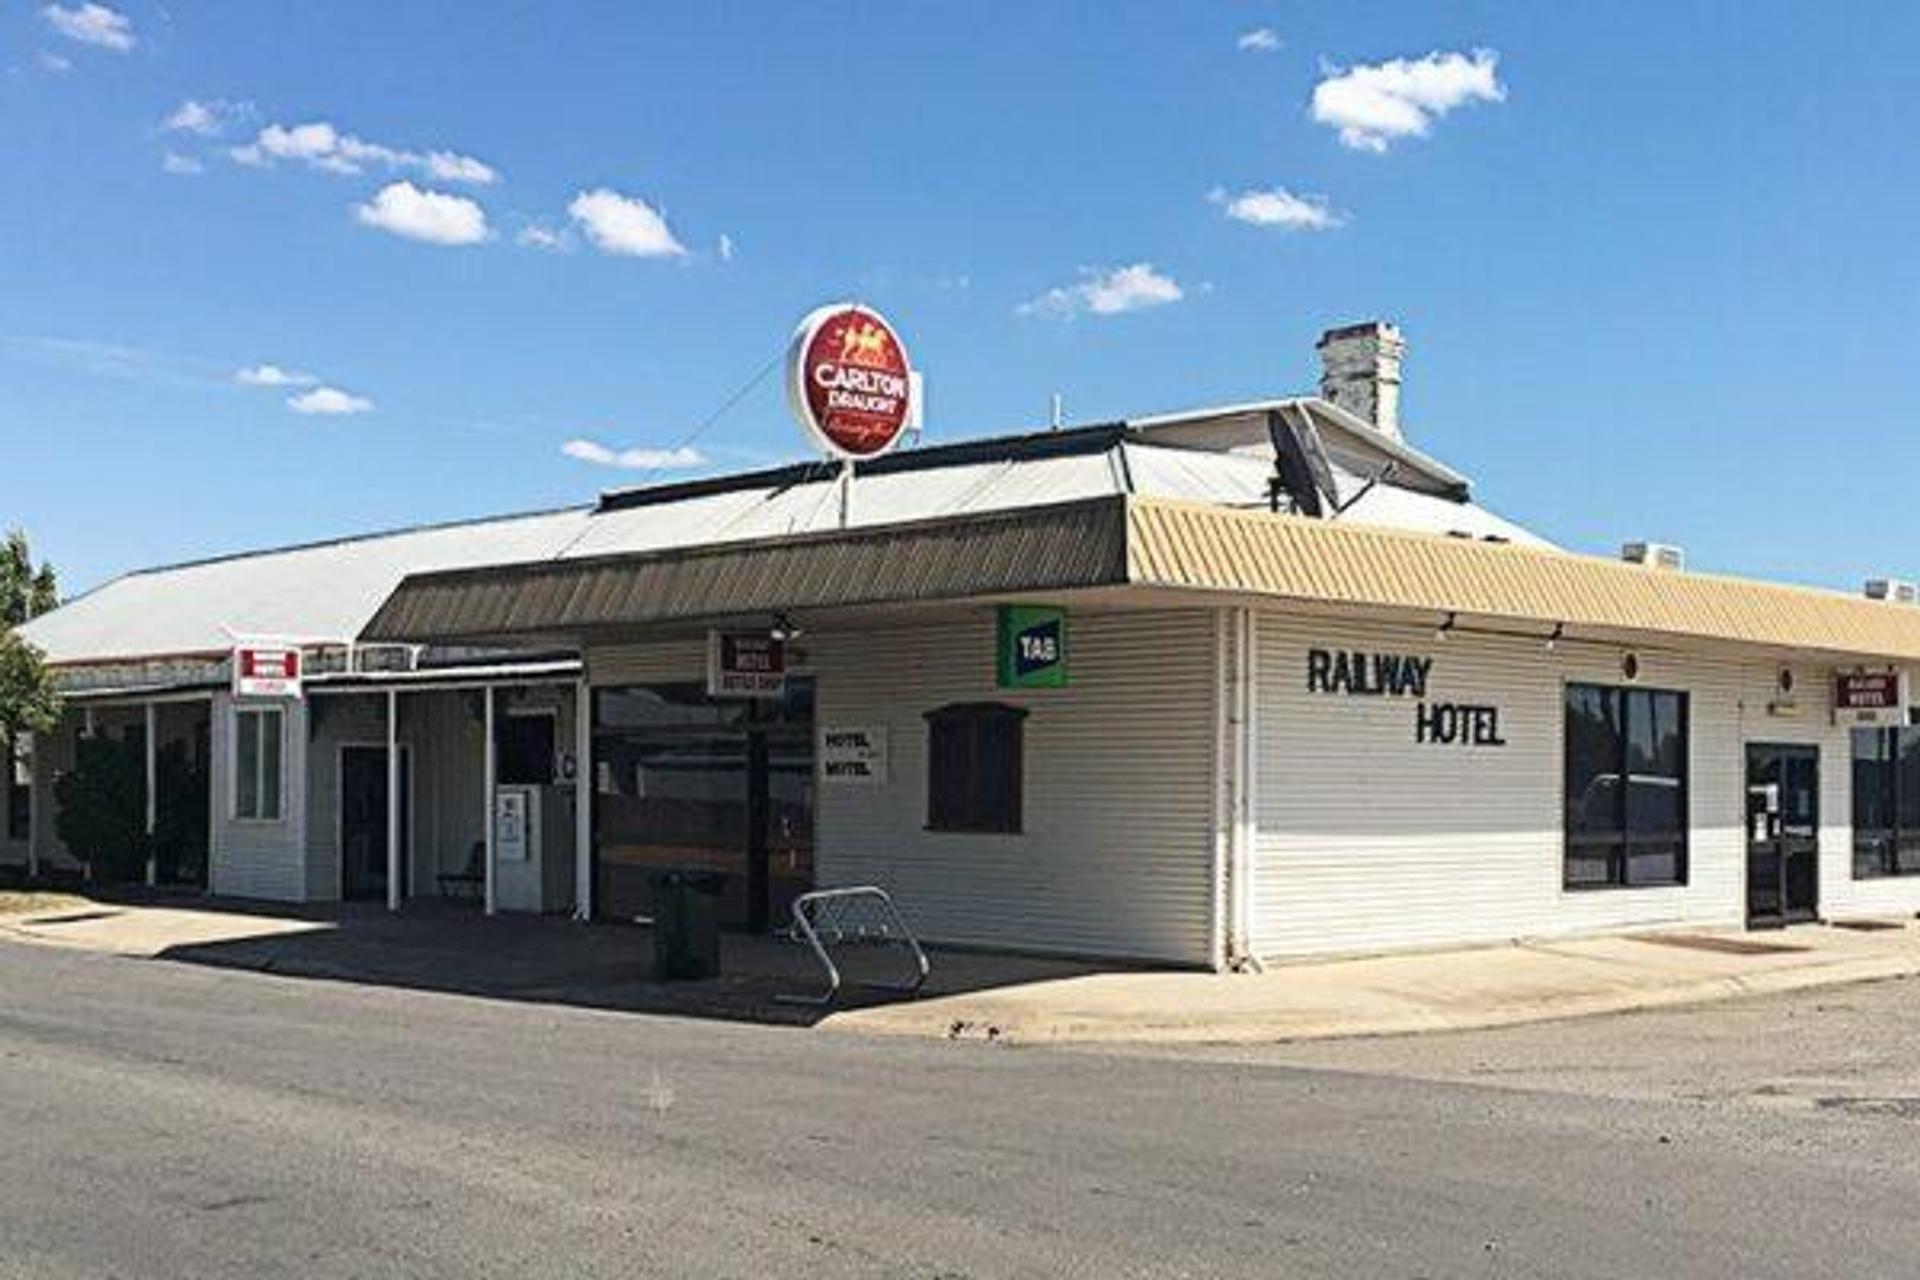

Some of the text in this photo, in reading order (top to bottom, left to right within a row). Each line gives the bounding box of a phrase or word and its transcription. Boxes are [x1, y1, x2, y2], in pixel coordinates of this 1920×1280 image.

[815, 364, 905, 399] CARLTON
[828, 390, 897, 414] DRAUGHT
[1020, 636, 1057, 660] TAB
[1307, 650, 1433, 697] RAILWAY
[1416, 702, 1506, 745] HOTEL
